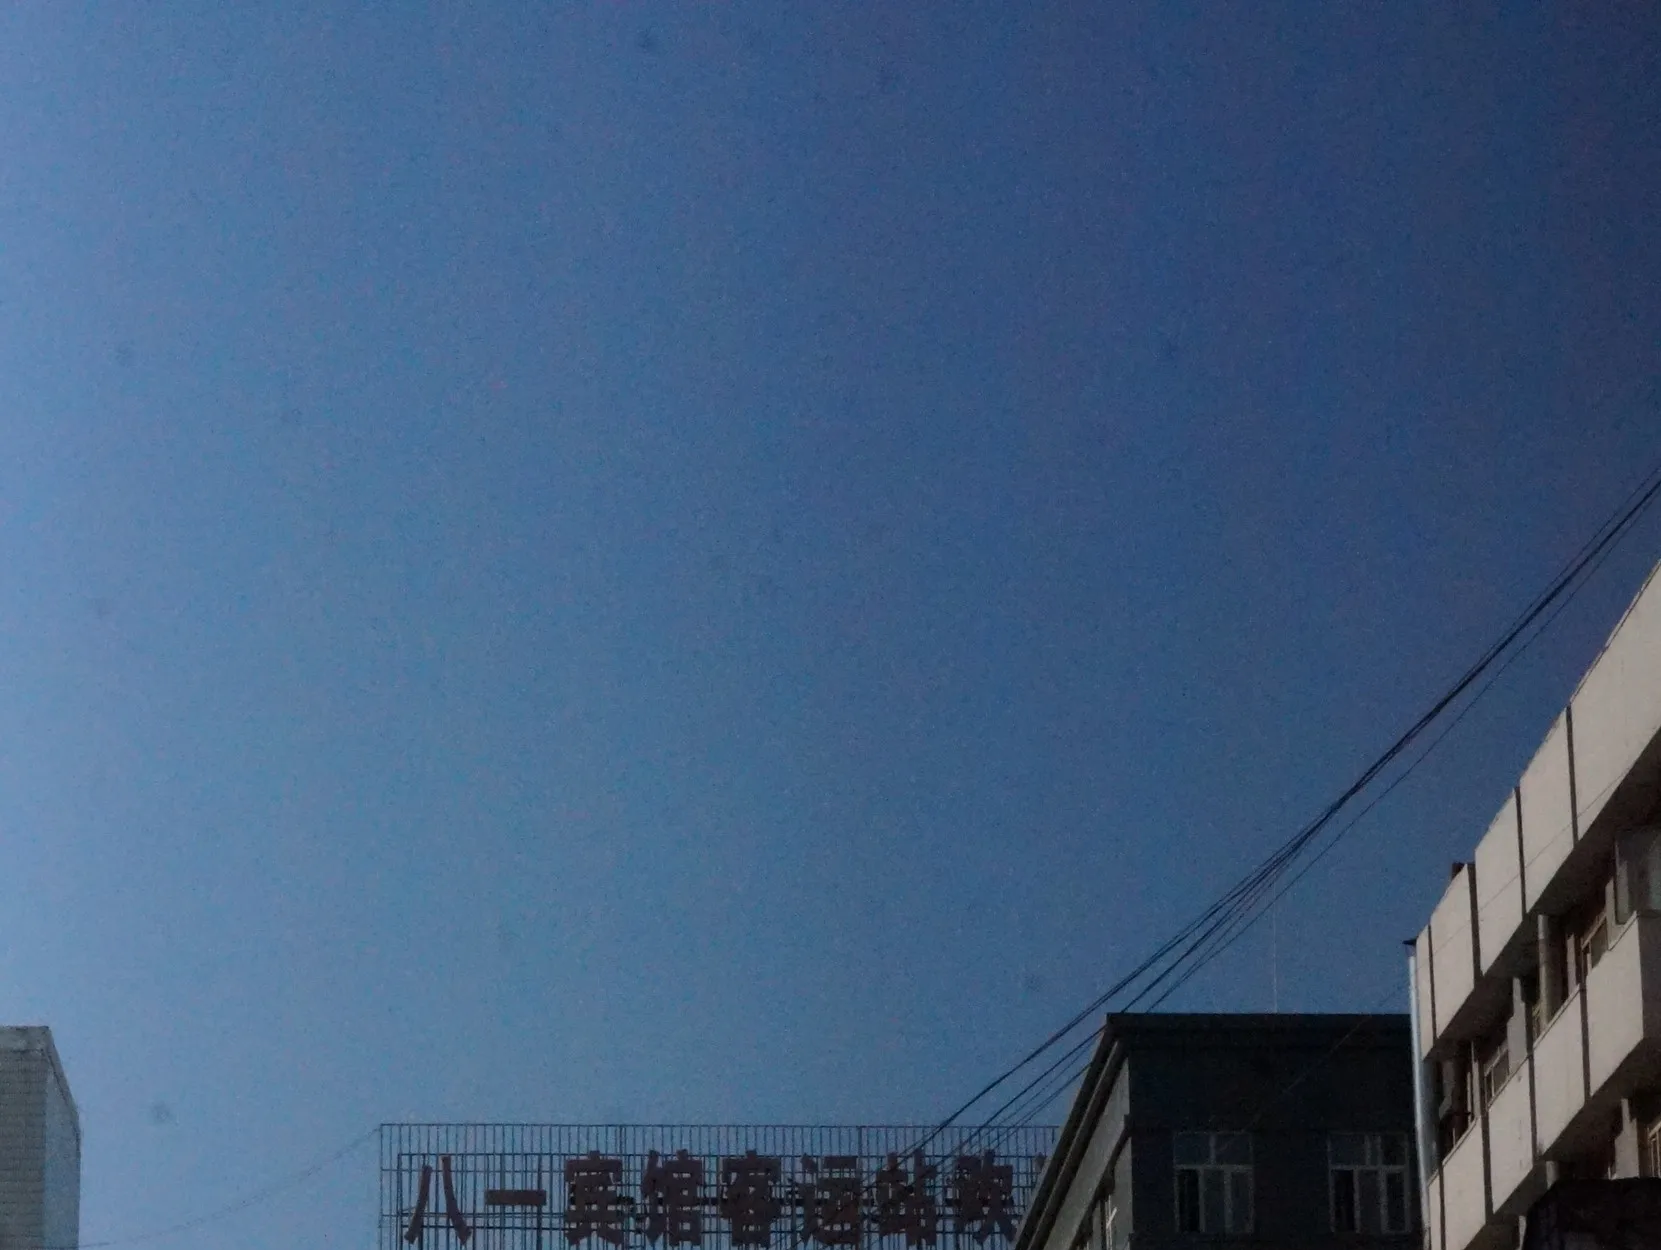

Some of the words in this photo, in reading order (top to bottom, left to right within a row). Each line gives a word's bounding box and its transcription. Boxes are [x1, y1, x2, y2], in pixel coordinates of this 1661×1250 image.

[404, 1150, 1042, 1246] 八一宾馆客运站欢
